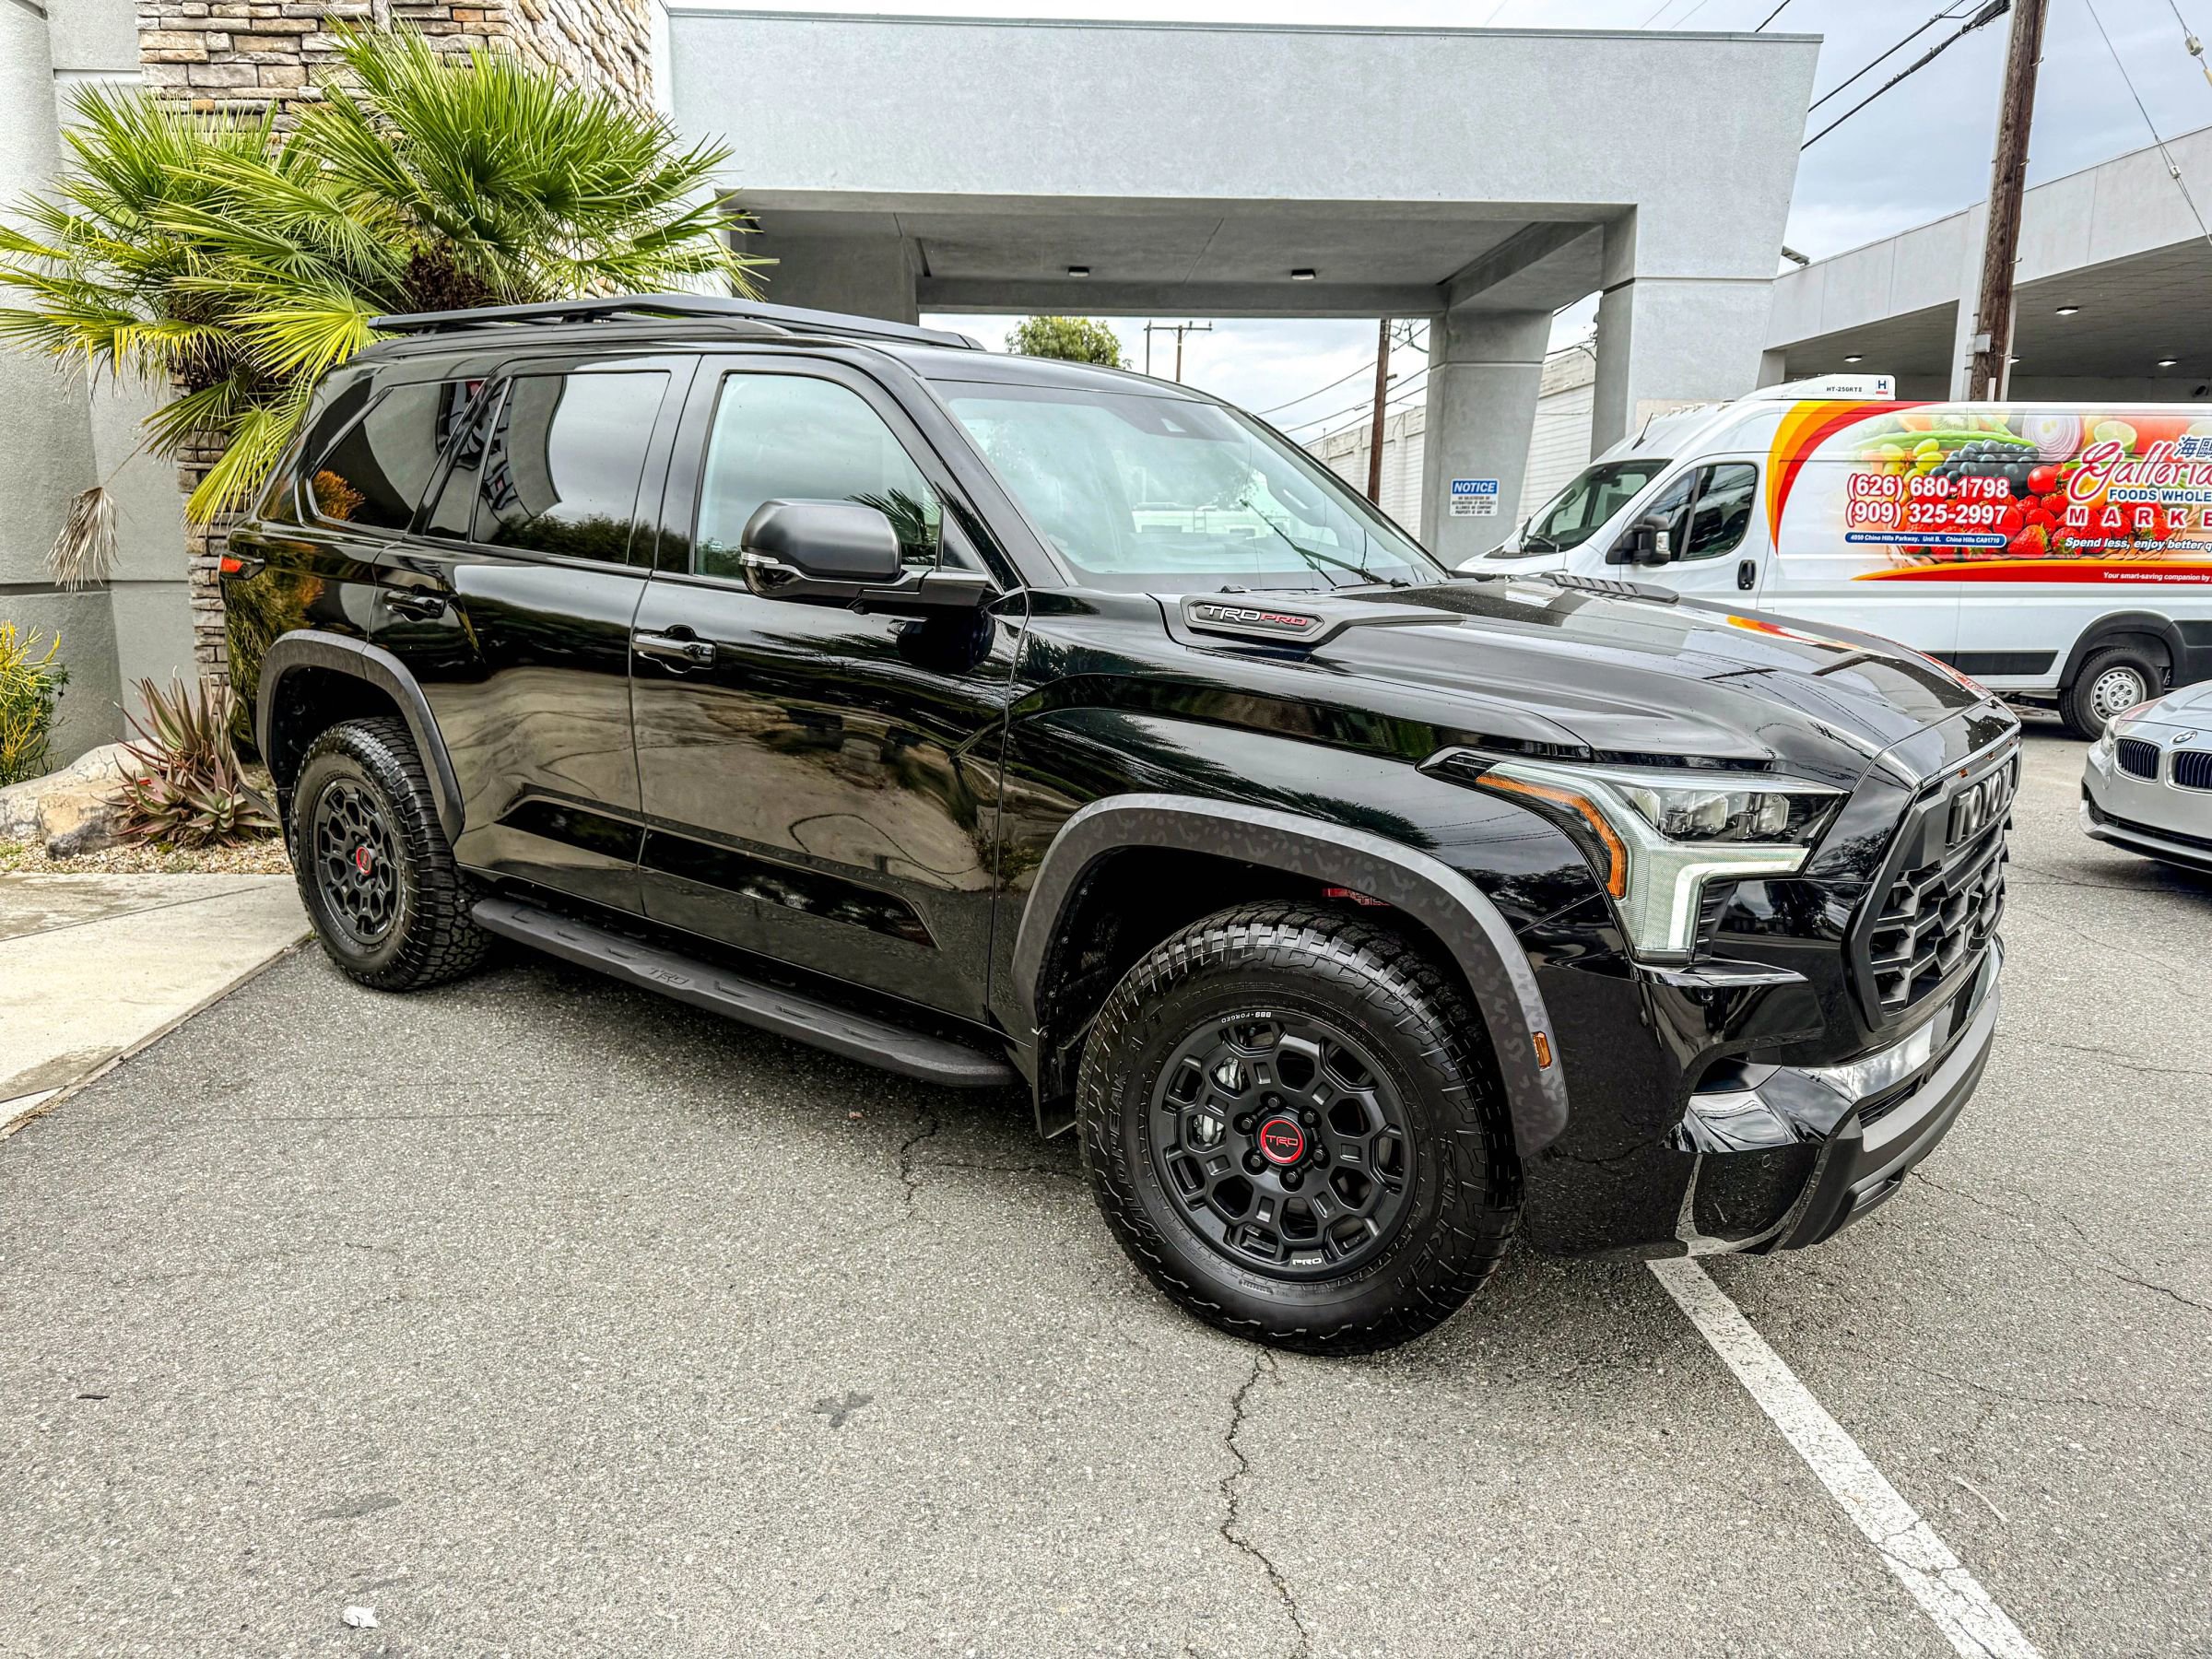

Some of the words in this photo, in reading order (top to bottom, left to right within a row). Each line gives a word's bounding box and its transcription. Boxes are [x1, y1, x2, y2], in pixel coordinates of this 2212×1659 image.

[1877, 380, 1887, 389] H
[1453, 482, 1496, 492] NOTICE
[1848, 474, 1903, 500] (626)
[1910, 477, 2009, 499] 680-1798
[2109, 489, 2157, 500] FOODS
[1846, 501, 1902, 528] (909)
[1908, 504, 2008, 525] 325-2997
[2068, 508, 2212, 527] MARKE
[2065, 537, 2101, 549] Spend
[2104, 538, 2131, 549] less,
[2134, 539, 2165, 551] enjoy
[2167, 540, 2203, 549] better
[1204, 605, 1261, 623] TRD
[1261, 614, 1308, 627] PRO
[1265, 1135, 1299, 1147] TRD
